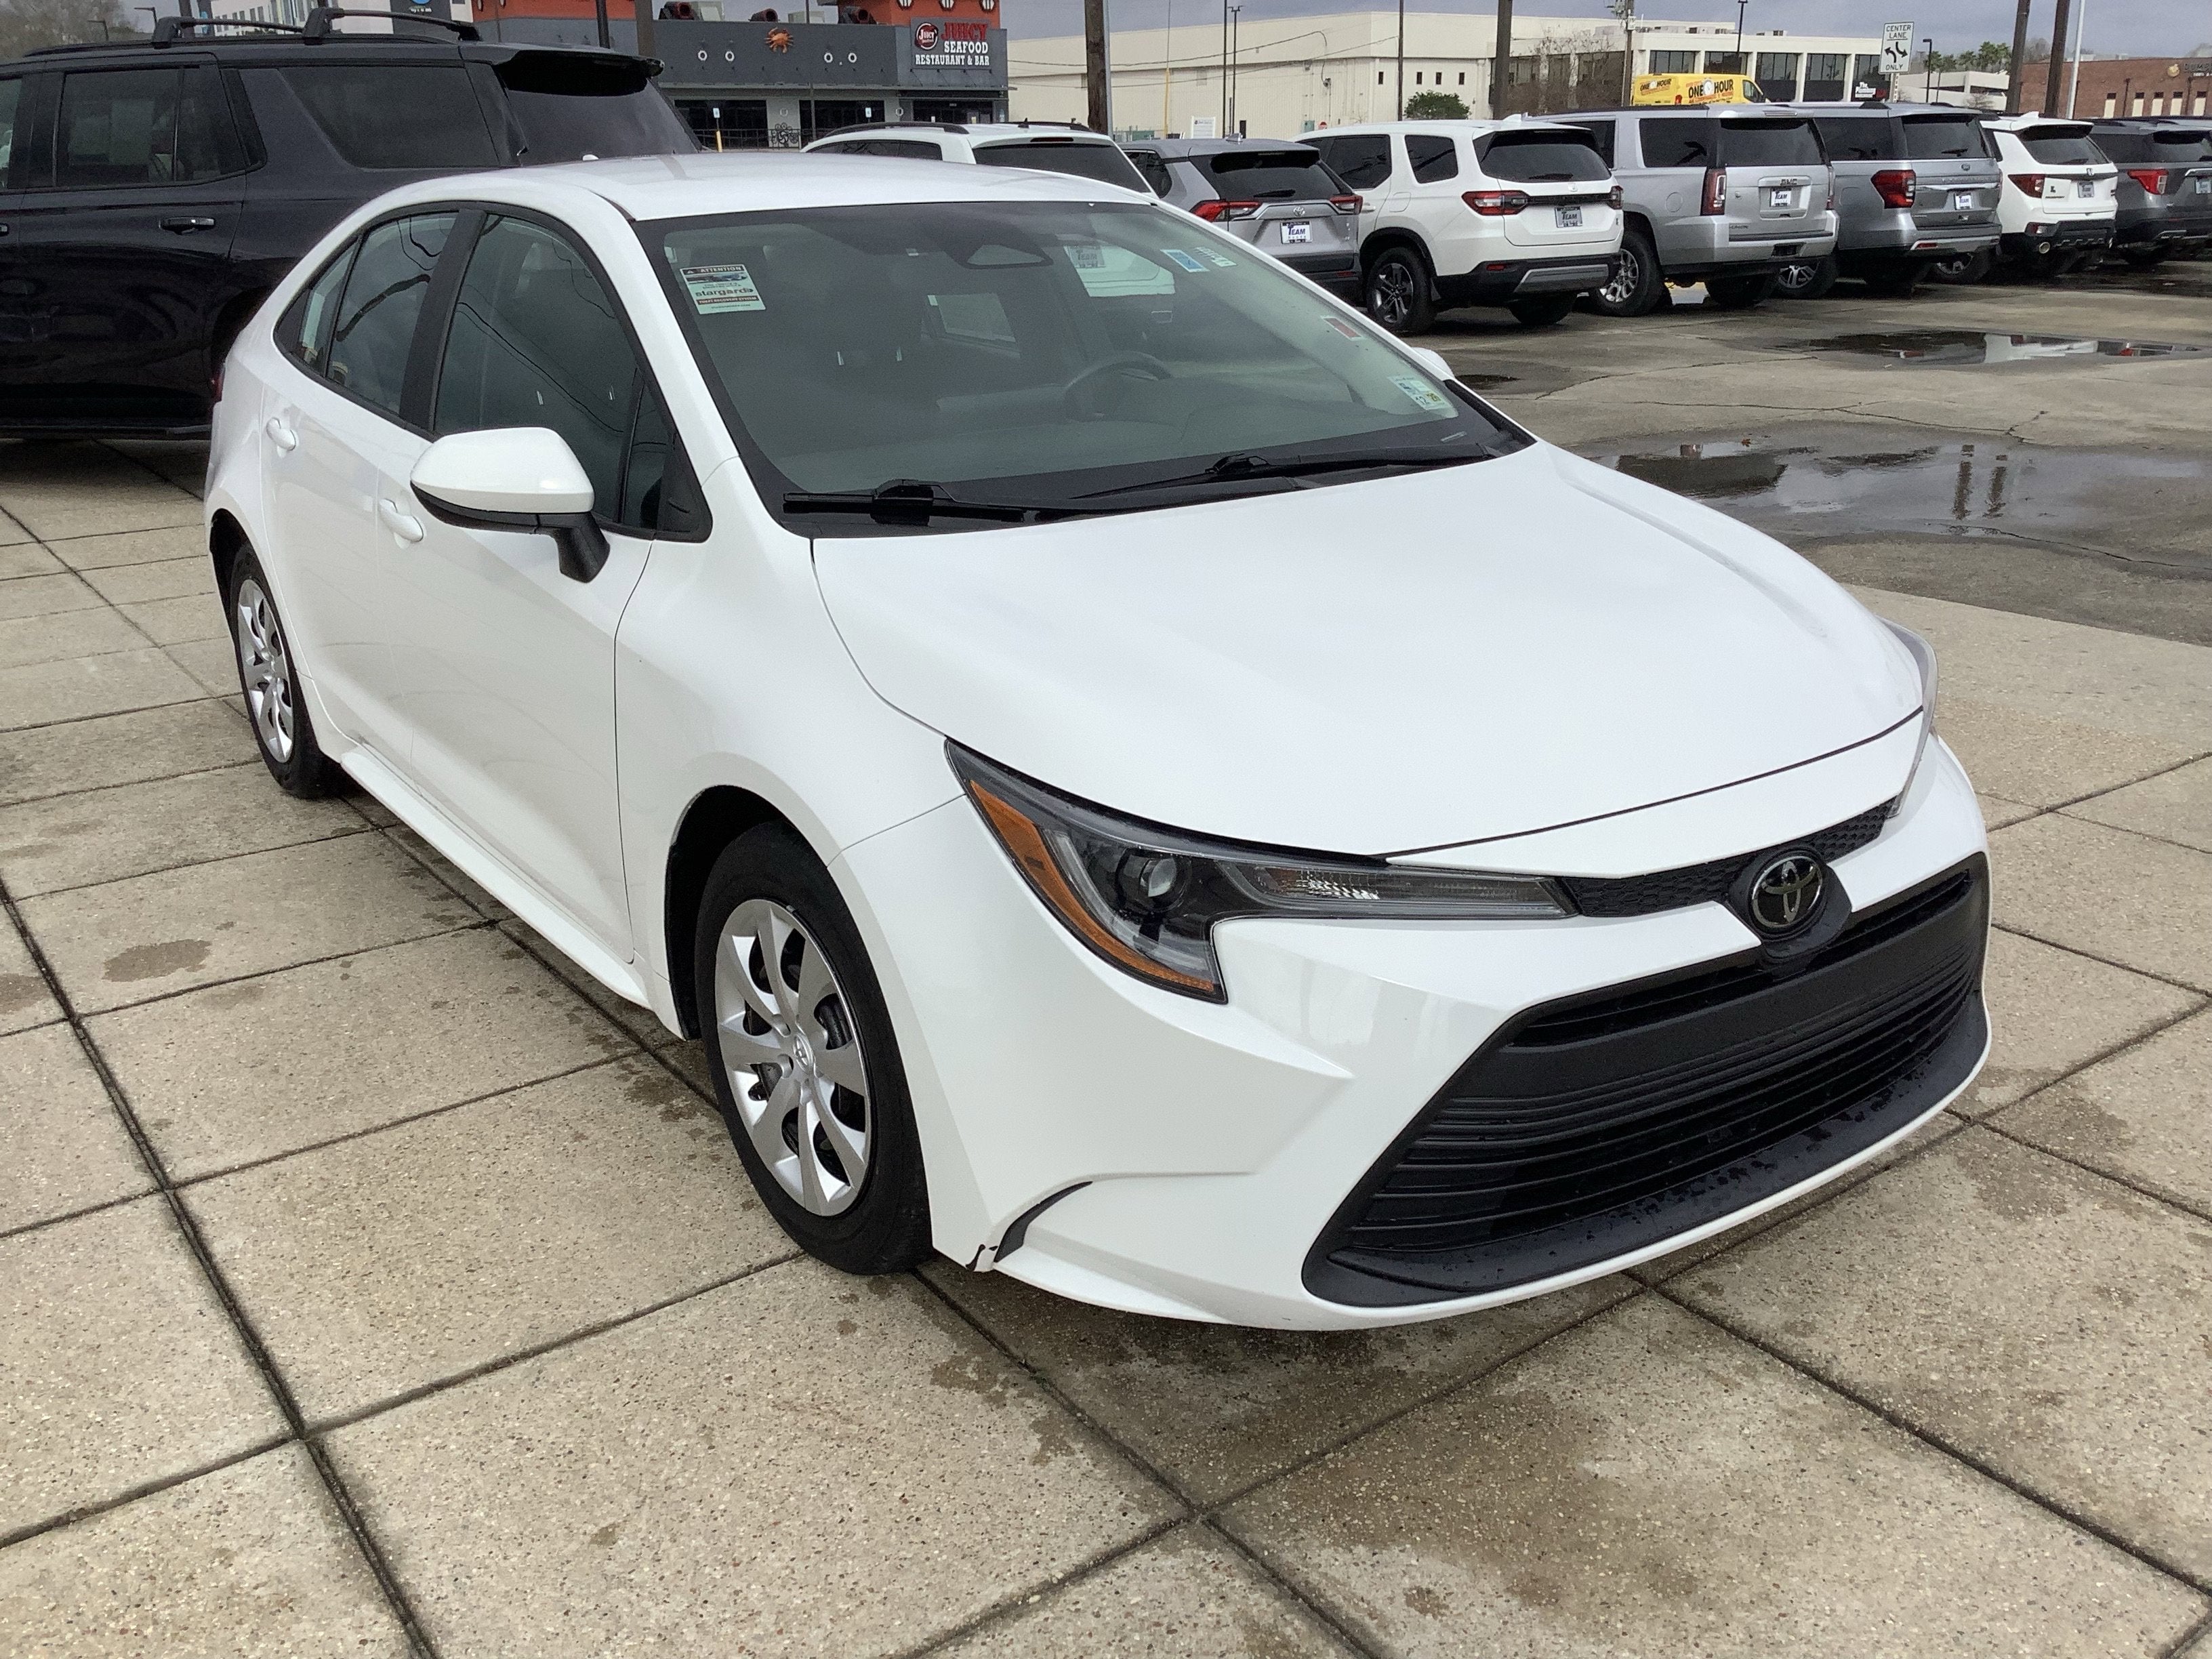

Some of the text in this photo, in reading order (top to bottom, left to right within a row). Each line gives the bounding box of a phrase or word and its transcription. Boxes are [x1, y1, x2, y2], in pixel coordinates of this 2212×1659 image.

[941, 22, 987, 40] JUICY
[944, 41, 988, 54] SEAFOOD
[916, 54, 989, 65] RESTAURANT & BAR
[1640, 83, 1650, 91] ONE
[1657, 79, 1671, 87] HOUR
[1688, 85, 1704, 98] ONE
[1714, 79, 1734, 94] HOUR
[1561, 211, 1578, 220] TEAM
[1288, 224, 1305, 235] TEAM
